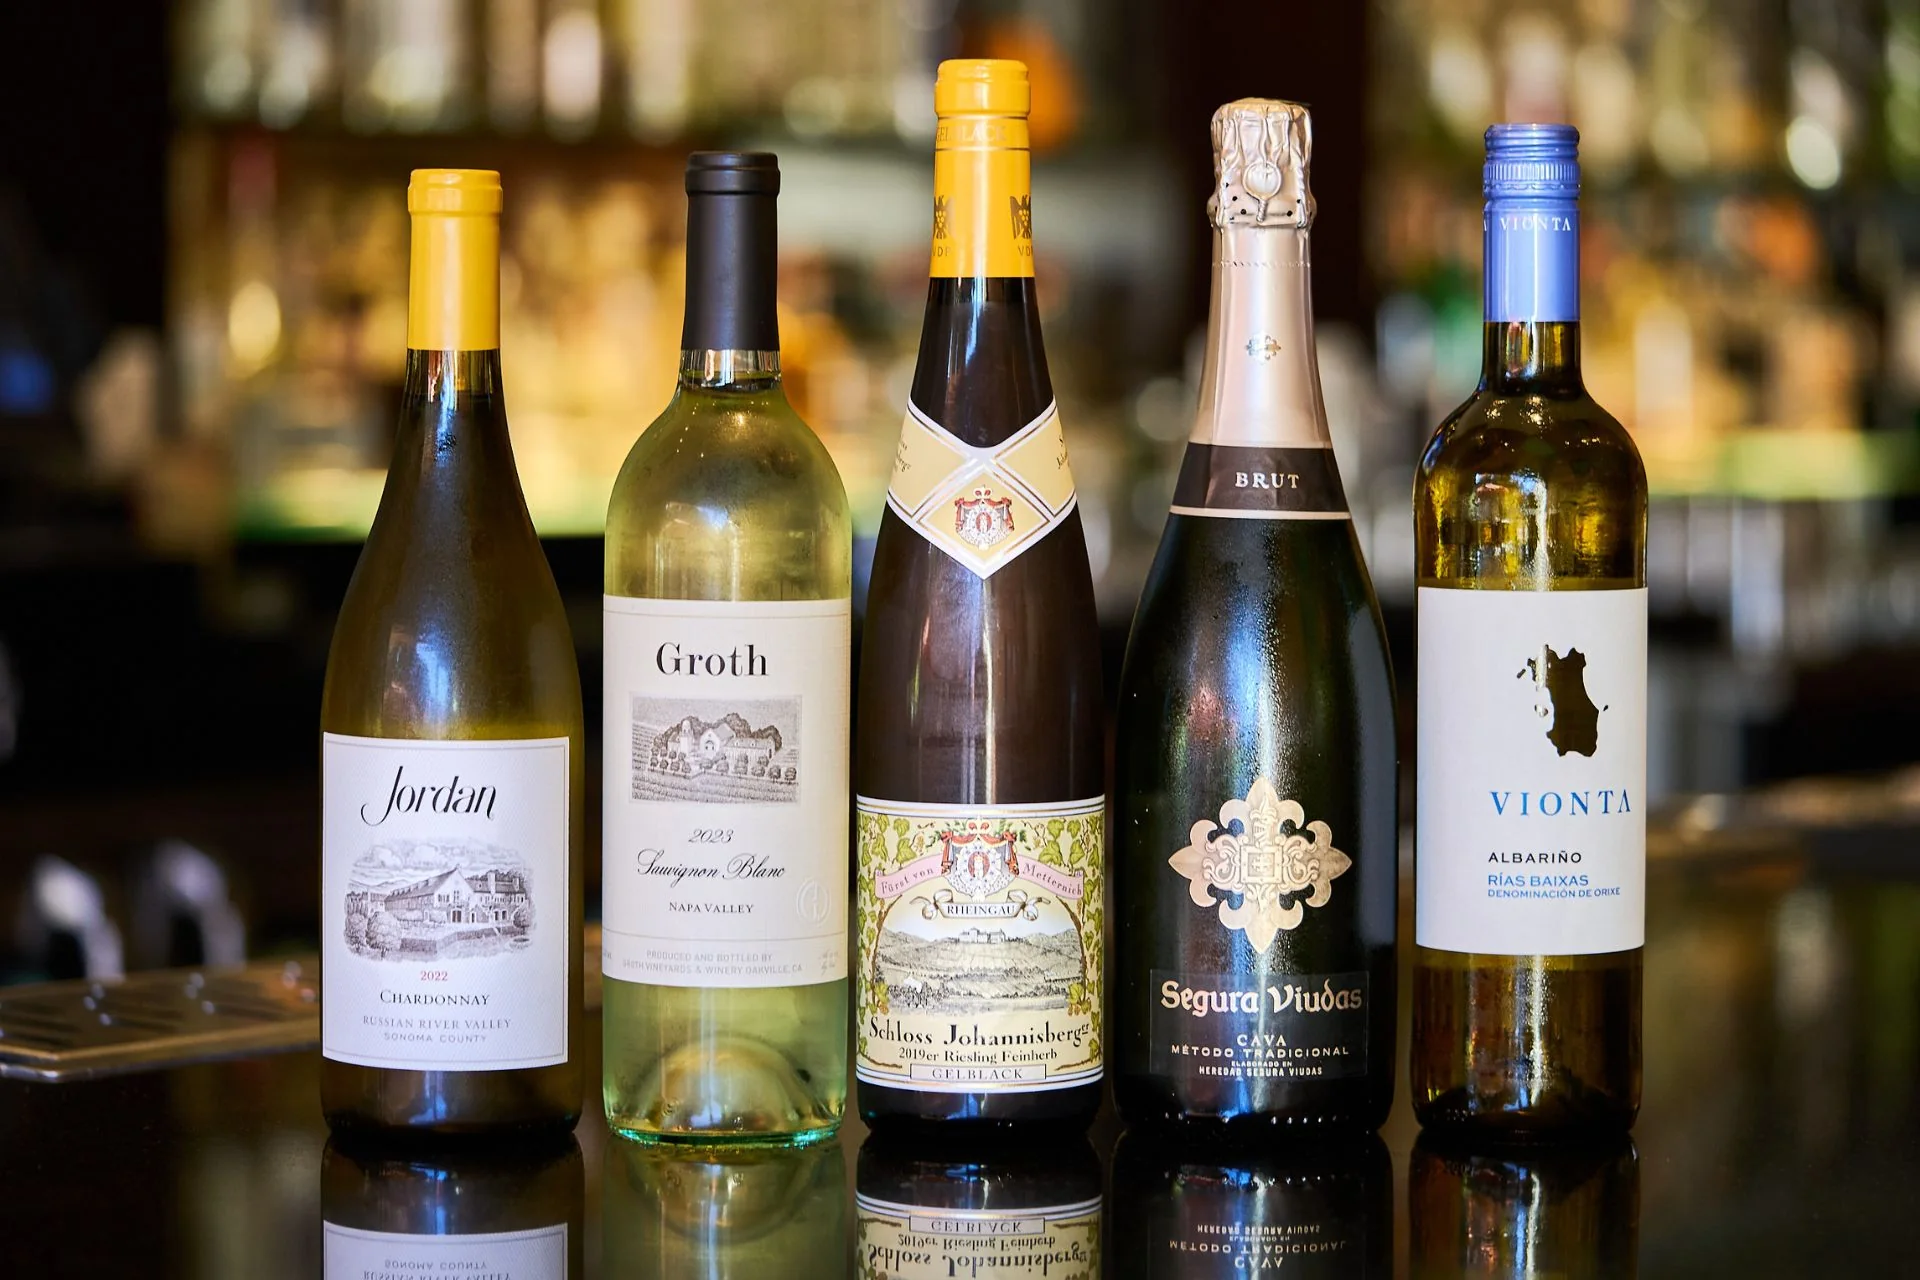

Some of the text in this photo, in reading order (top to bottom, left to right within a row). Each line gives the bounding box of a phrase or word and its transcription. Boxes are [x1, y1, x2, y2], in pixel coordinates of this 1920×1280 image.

[1500, 217, 1571, 231] VIONTA
[1235, 471, 1299, 489] BRUT
[656, 642, 769, 677] Groth
[360, 765, 497, 827] Jordan
[1490, 788, 1632, 817] VIONTA
[688, 829, 734, 844] 2023
[1488, 850, 1583, 864] ALBARIÑO
[637, 849, 786, 888] Sauvignon Blanc
[913, 868, 934, 879] von
[1022, 861, 1083, 896] Metternich
[1487, 872, 1589, 887] RÍAS BAIXAS
[1487, 887, 1621, 899] DENOMINACIÓN DE ORIXE
[669, 901, 754, 914] NAPA VALLEY
[946, 903, 1015, 916] RHEINGAU
[646, 950, 773, 962] PRODUCED AND BOTTLED BY
[420, 971, 448, 982] 2022
[705, 965, 744, 975] WINERY
[380, 989, 490, 1006] CHARDONNAY
[1160, 978, 1362, 1017] Segura Viudas
[363, 1015, 512, 1029] RUSSIAN RIVER VALLEY
[869, 1016, 933, 1045] Schloss
[384, 1032, 487, 1044] SONOMA COUNTY
[1237, 1034, 1287, 1047] CAVA
[899, 1047, 1057, 1065] 2019er Riesling Feinherb
[1171, 1044, 1349, 1059] MÉTODO TRADICIONAL
[932, 1068, 1023, 1080] GELBLACK
[1199, 1065, 1323, 1077] HEREDAD SEGURA VIUDAS
